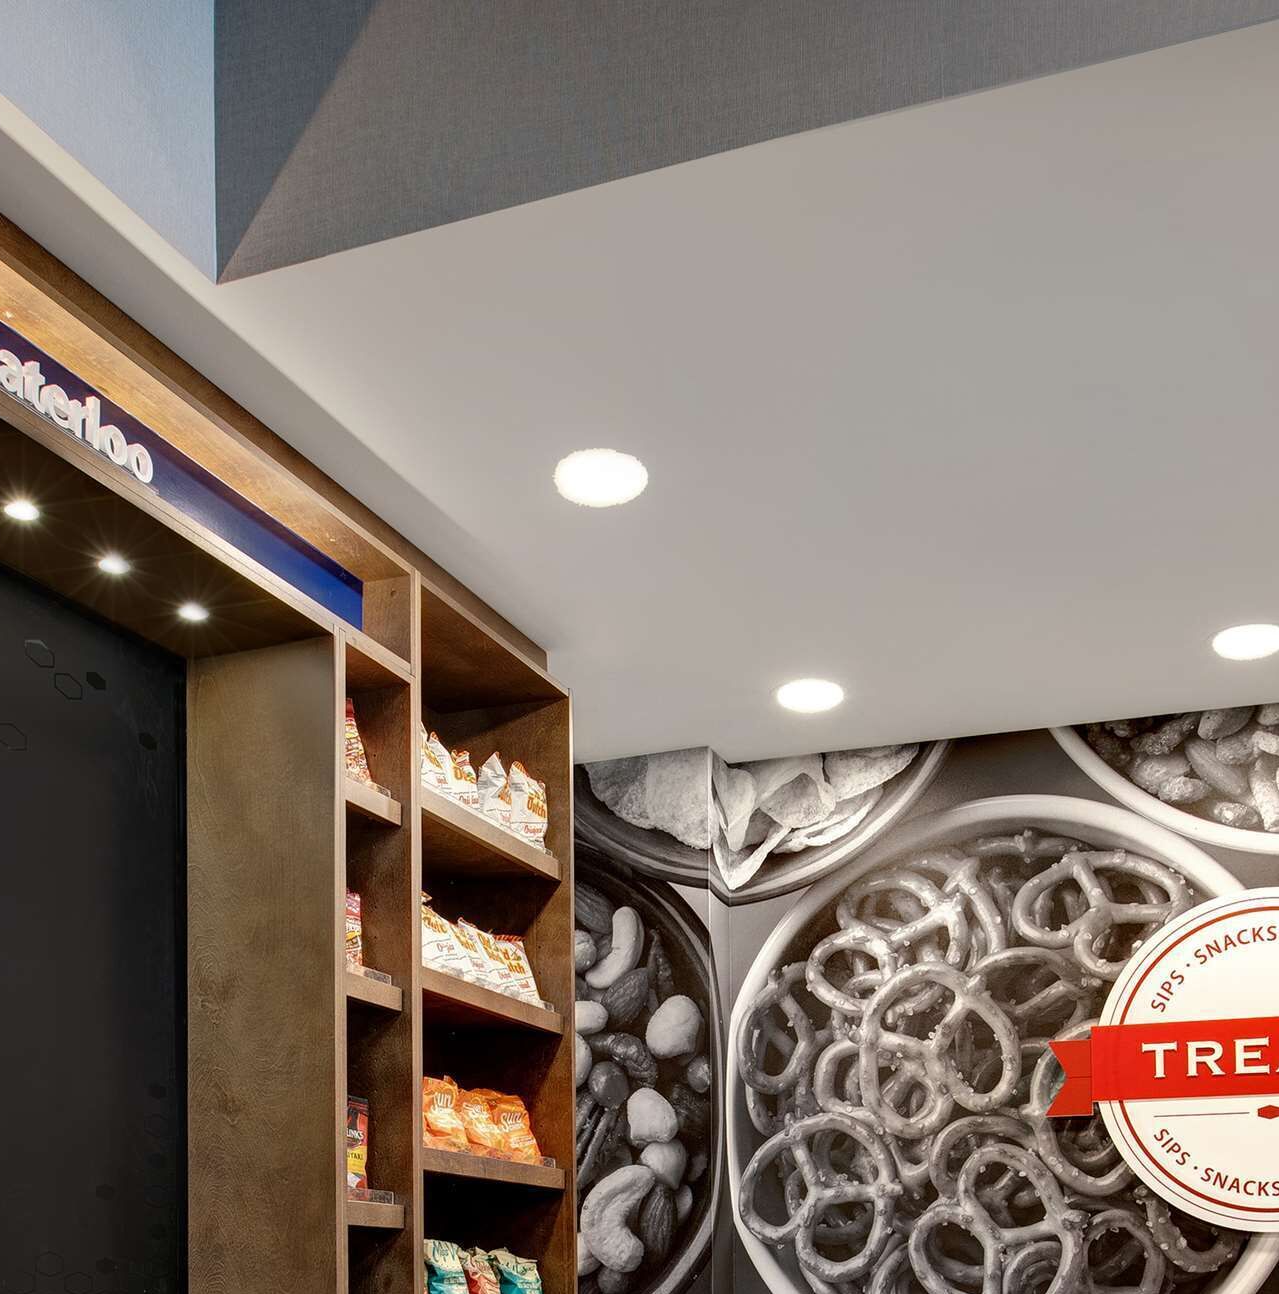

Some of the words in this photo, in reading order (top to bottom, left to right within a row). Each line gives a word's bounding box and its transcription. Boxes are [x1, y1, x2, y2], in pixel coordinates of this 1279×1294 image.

[1151, 969, 1185, 1013] SIPS
[1194, 925, 1278, 965] SNACKS
[1154, 1127, 1190, 1166] SIPS
